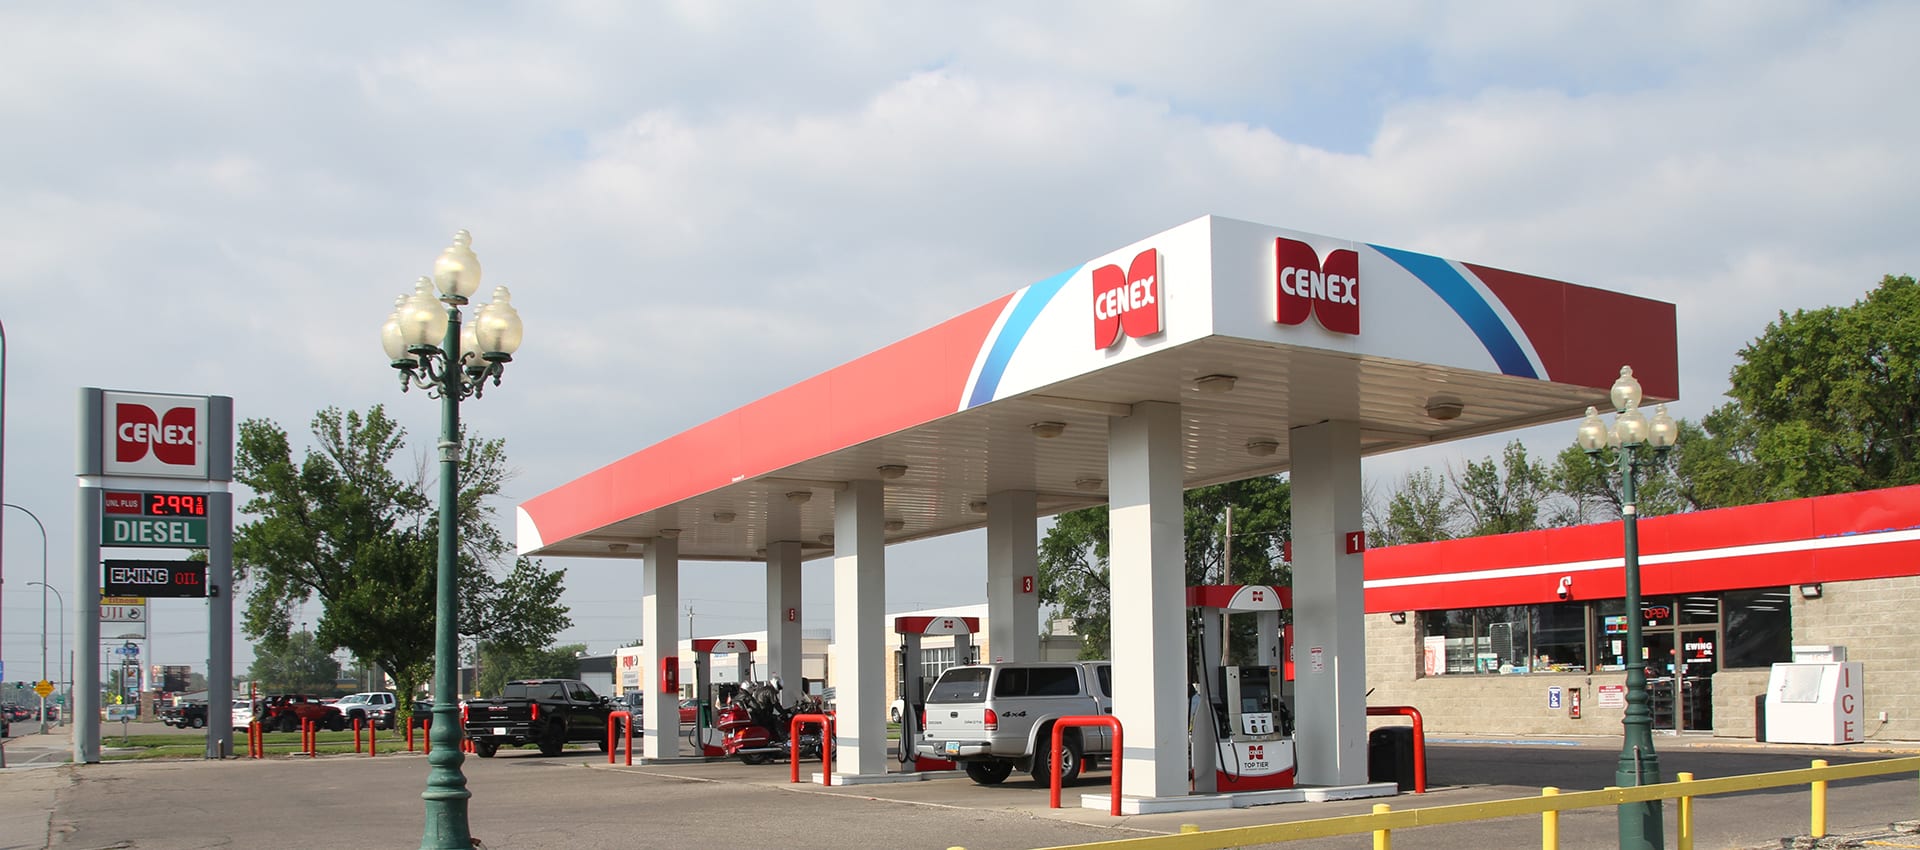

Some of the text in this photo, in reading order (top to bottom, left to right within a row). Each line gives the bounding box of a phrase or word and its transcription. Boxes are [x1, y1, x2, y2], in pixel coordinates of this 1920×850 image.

[1280, 267, 1356, 305] CENEX
[1095, 275, 1155, 320] CENEX
[118, 422, 194, 445] CENEX
[121, 500, 138, 508] PLUS
[152, 495, 194, 514] 2.99
[114, 521, 196, 543] DIESEL
[1352, 534, 1359, 551] 1
[111, 567, 199, 585] EWING OIL
[1025, 578, 1031, 591] 3
[100, 606, 124, 619] UJI
[1644, 608, 1669, 618] OPEN
[1271, 645, 1277, 657] 1
[1685, 642, 1712, 650] EWING
[1842, 668, 1854, 741] ICE
